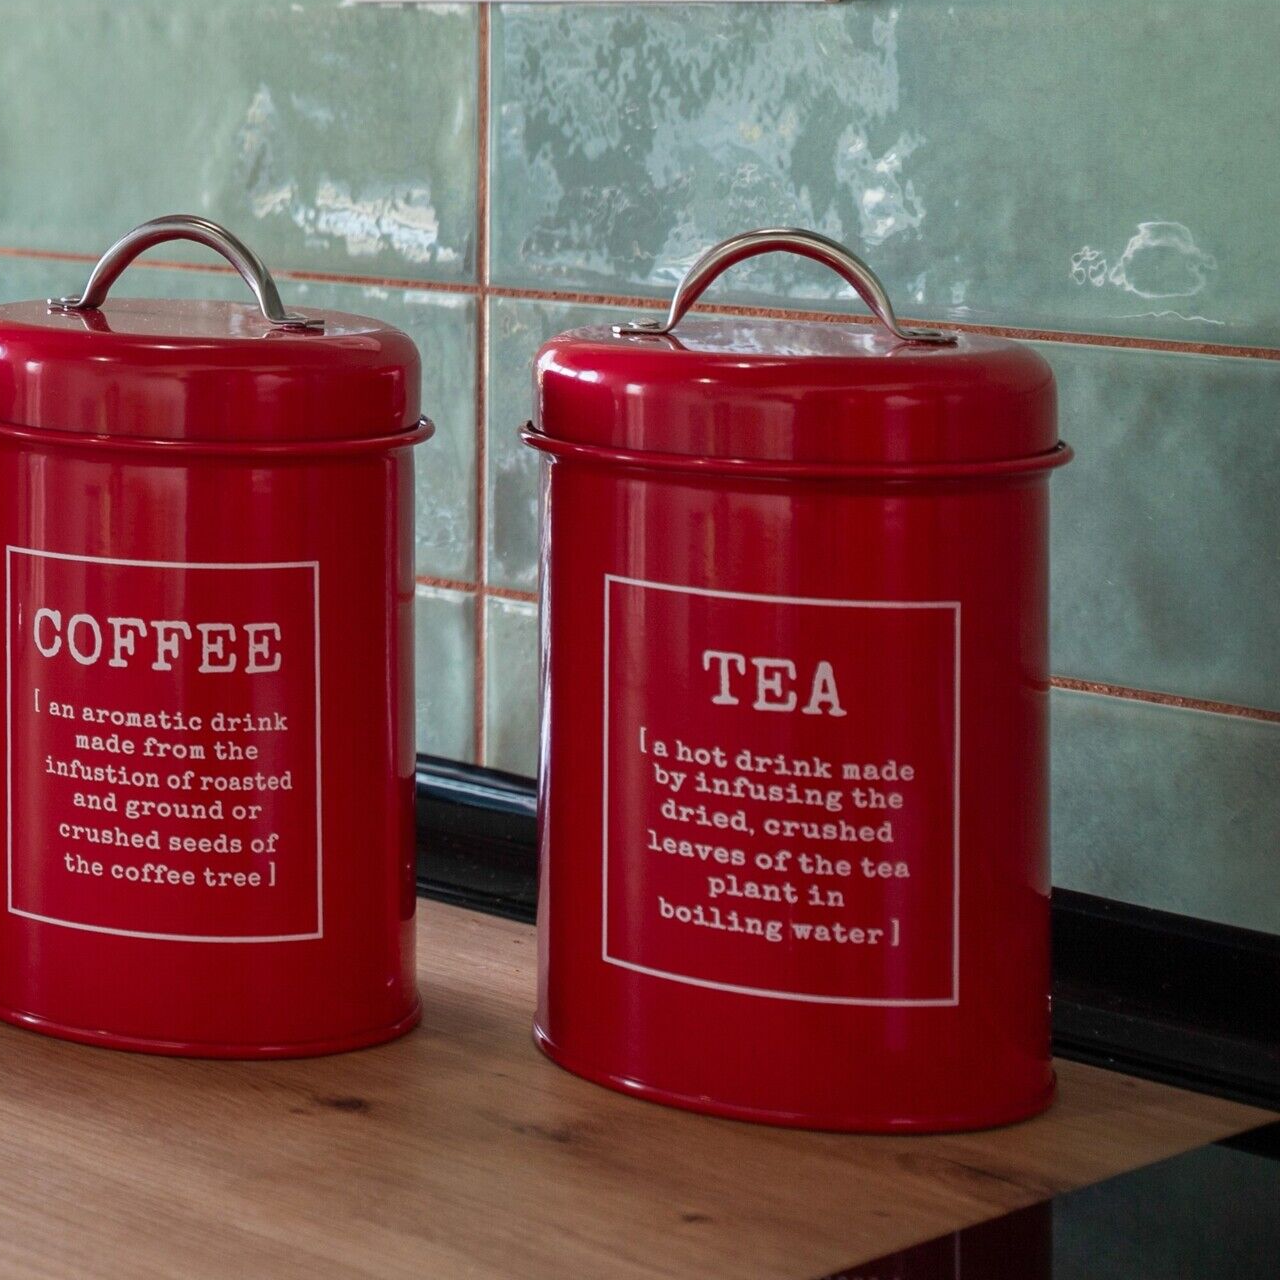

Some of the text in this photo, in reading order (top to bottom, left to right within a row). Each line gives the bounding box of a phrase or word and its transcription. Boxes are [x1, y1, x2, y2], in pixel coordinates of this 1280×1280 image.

[33, 607, 281, 673] COFFEE
[703, 650, 846, 716] TEA
[49, 702, 74, 719] an
[82, 707, 201, 730] aromatic
[211, 712, 287, 731] drink
[76, 734, 258, 760] made from the
[676, 740, 727, 767] hot
[736, 750, 831, 780] drink
[843, 760, 914, 781] made
[46, 755, 292, 791] infustion of roasted
[654, 764, 903, 813] by infusing the
[74, 793, 262, 819] and ground or
[661, 799, 893, 842] dried, crushed
[59, 823, 279, 853] crushed seeds of
[648, 829, 910, 878] leaves of the tea
[64, 853, 103, 876] the
[111, 863, 195, 885] coffee
[204, 868, 261, 886] tree
[708, 875, 844, 907] plant in
[659, 896, 782, 942] boiling
[791, 923, 883, 944] water
